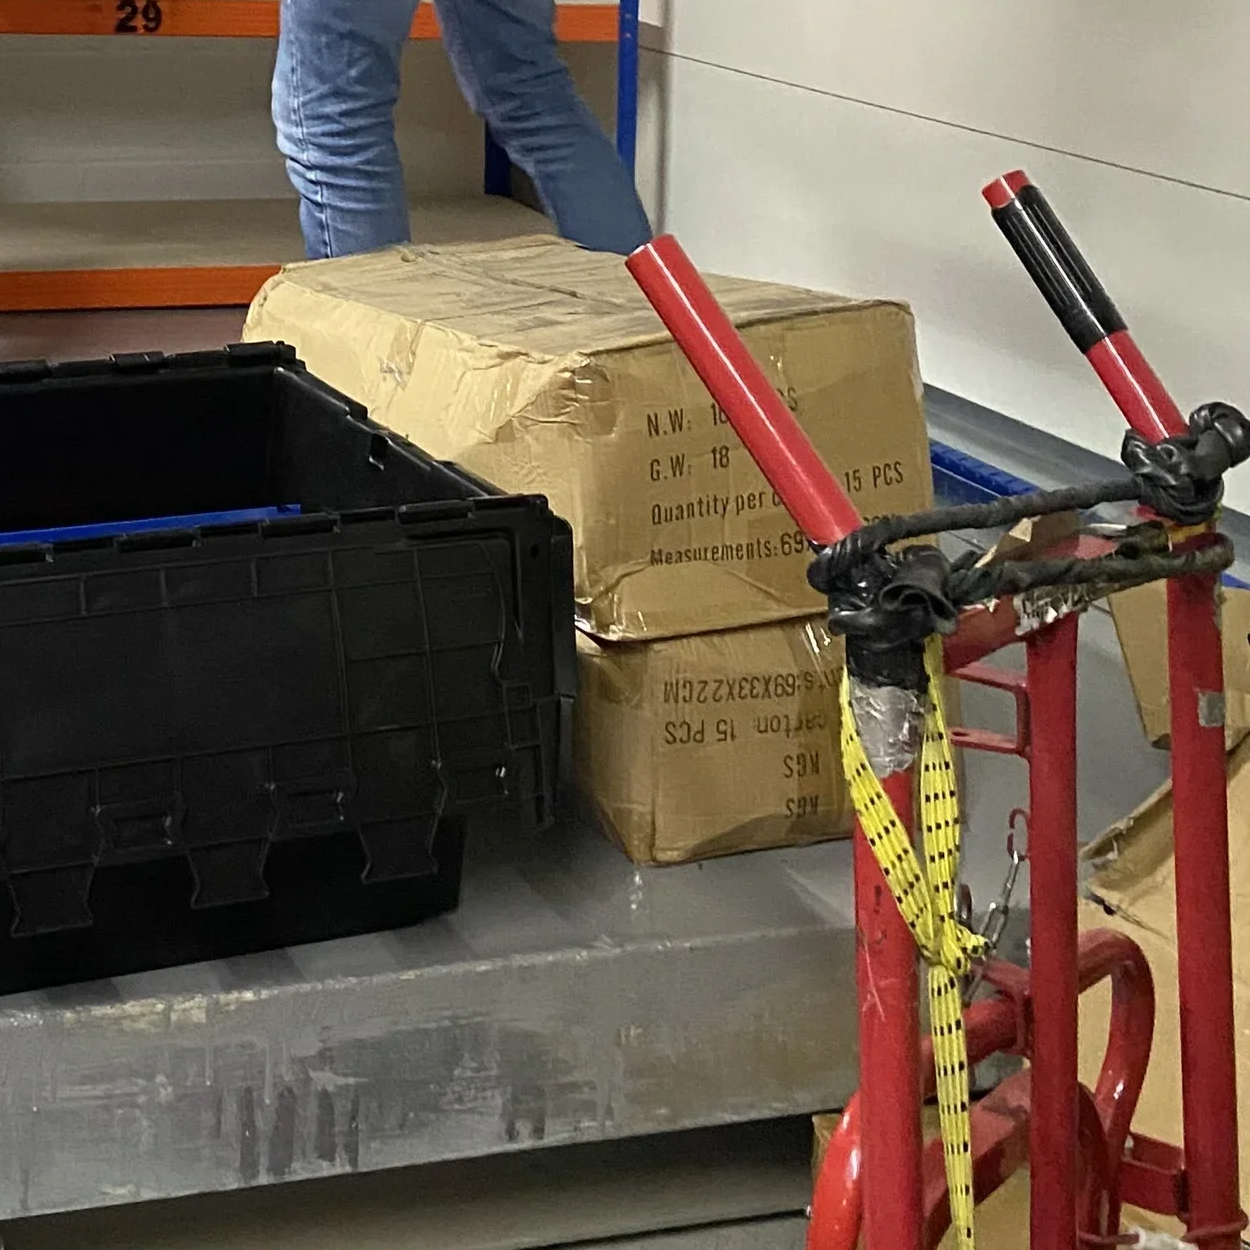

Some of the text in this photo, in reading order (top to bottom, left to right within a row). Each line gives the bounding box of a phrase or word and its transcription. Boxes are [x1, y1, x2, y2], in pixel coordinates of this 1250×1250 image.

[646, 408, 692, 437] N.W:
[649, 445, 730, 482] G.W: 18
[651, 494, 730, 526] Quantity
[735, 491, 766, 517] per
[843, 469, 862, 493] 15
[872, 461, 904, 488] PCS
[664, 719, 705, 746] PCS
[716, 718, 737, 742] 15
[782, 751, 820, 779] KGS
[785, 794, 819, 820] KGS
